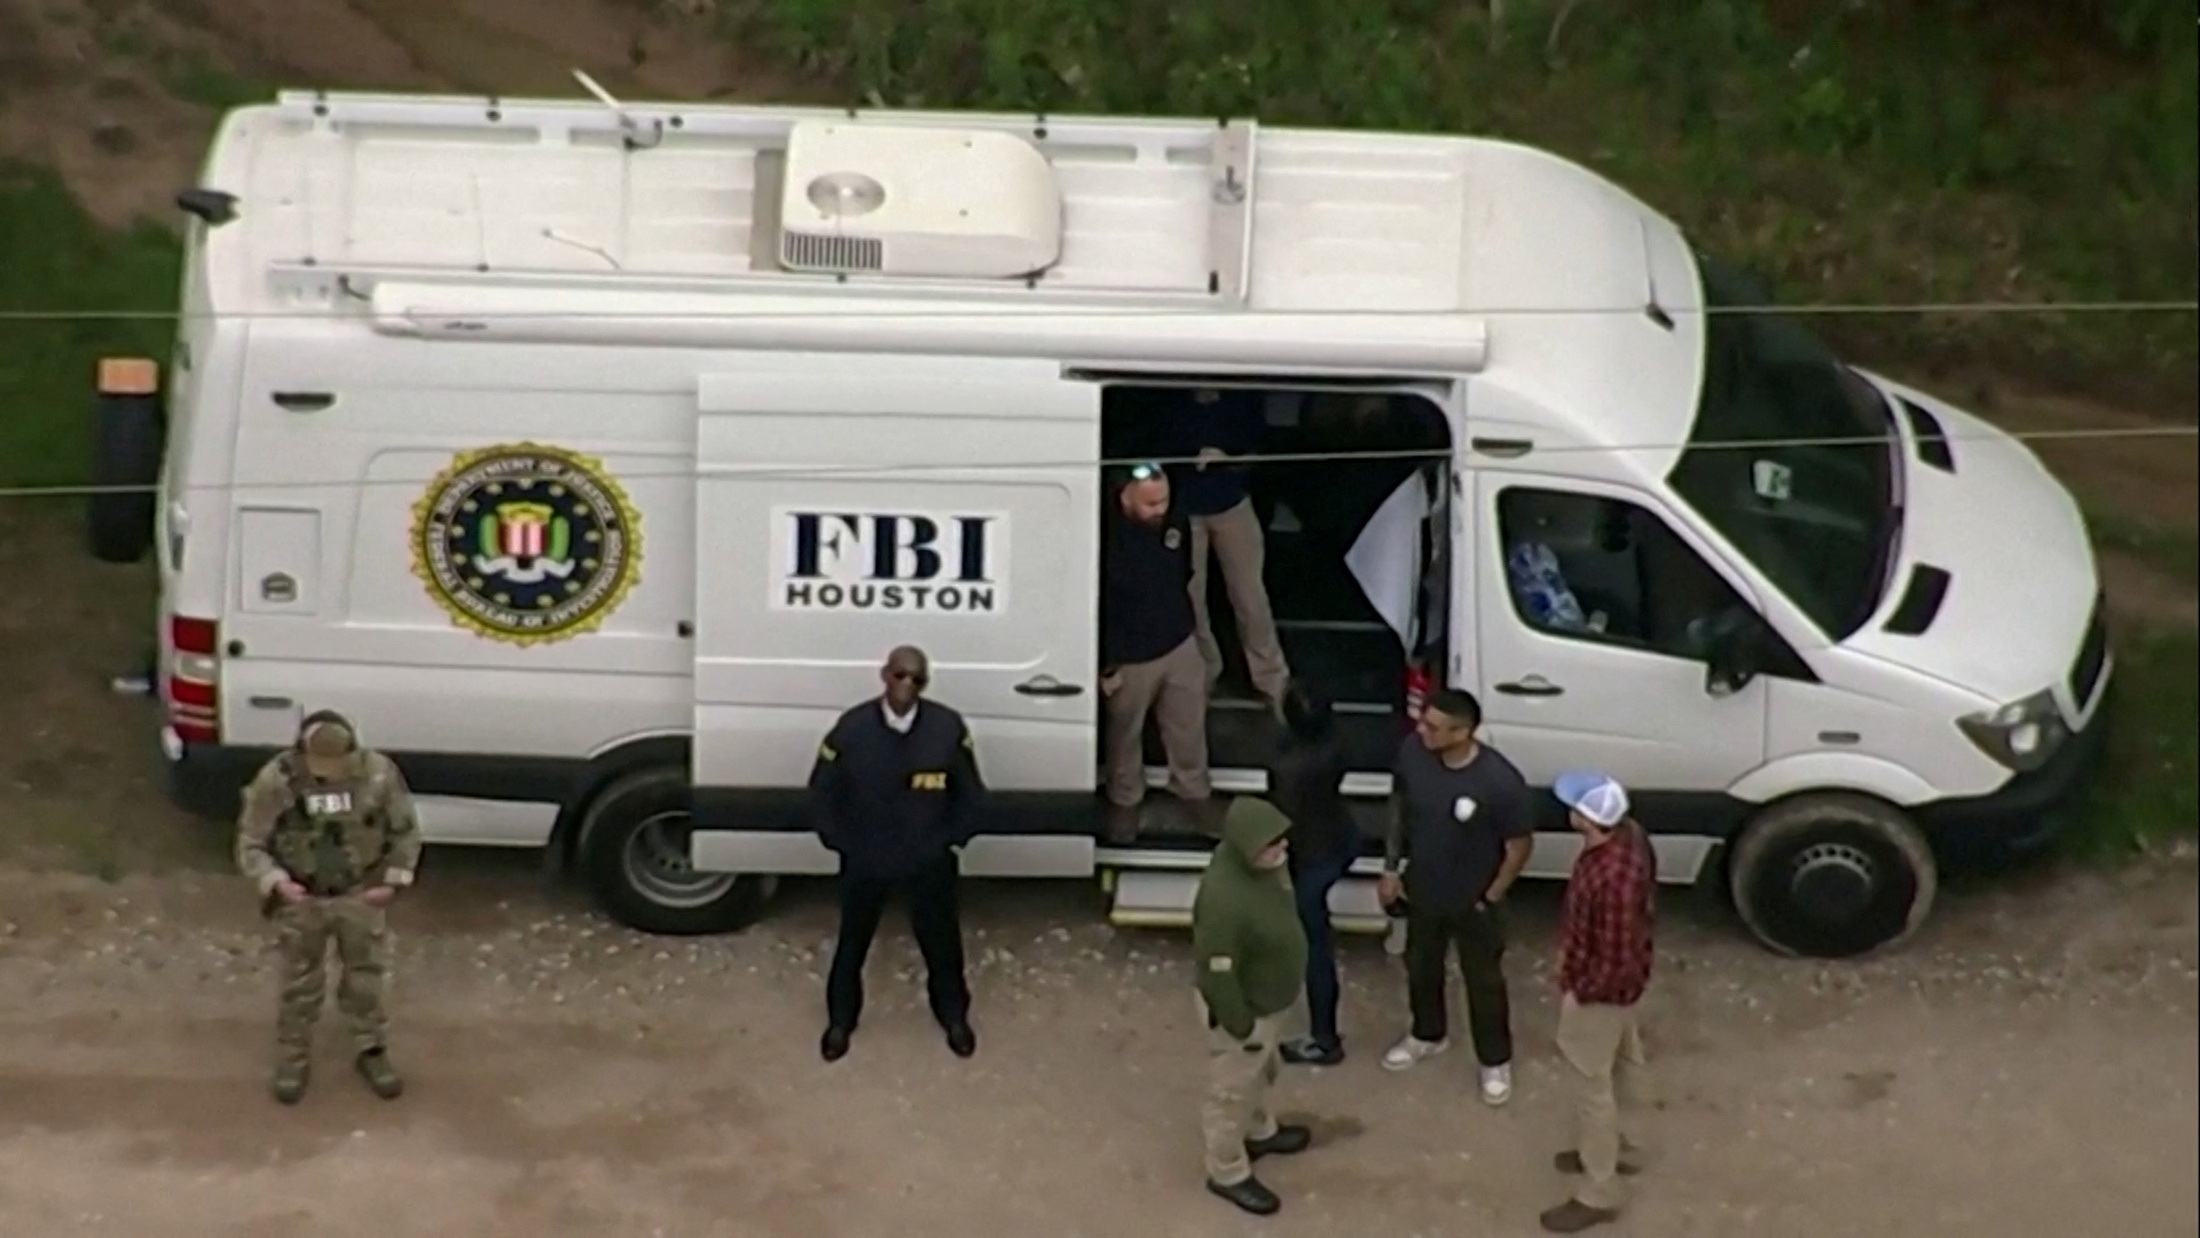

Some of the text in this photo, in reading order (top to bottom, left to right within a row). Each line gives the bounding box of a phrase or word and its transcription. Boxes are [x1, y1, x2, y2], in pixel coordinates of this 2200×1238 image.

[785, 511, 997, 582] FBI
[786, 583, 994, 611] HOUSTON
[911, 772, 947, 789] FBI
[307, 792, 352, 814] FBI
